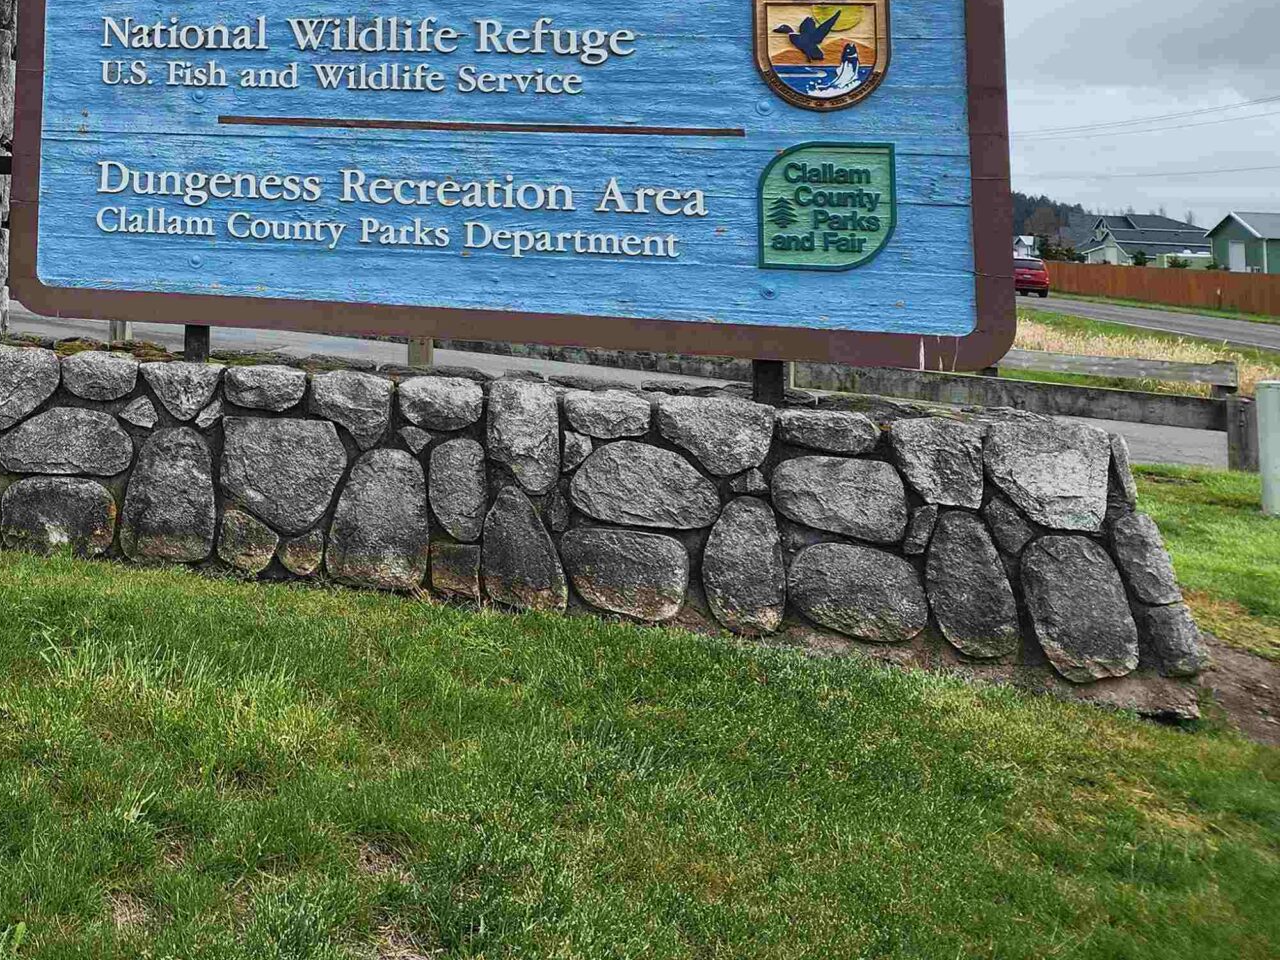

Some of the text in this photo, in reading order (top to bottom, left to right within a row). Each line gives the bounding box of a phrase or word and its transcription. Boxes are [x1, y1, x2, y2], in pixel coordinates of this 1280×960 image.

[101, 16, 636, 66] National Wildlife Refuge
[100, 60, 583, 94] U.S. Fish and Wildlife Service
[96, 160, 709, 217] Dungeness Recreation Area
[784, 162, 871, 185] Clallam
[795, 185, 880, 212] County
[96, 206, 680, 258] Clallam County Parks Department
[813, 209, 880, 232] Parks
[771, 231, 867, 253] and Fair
